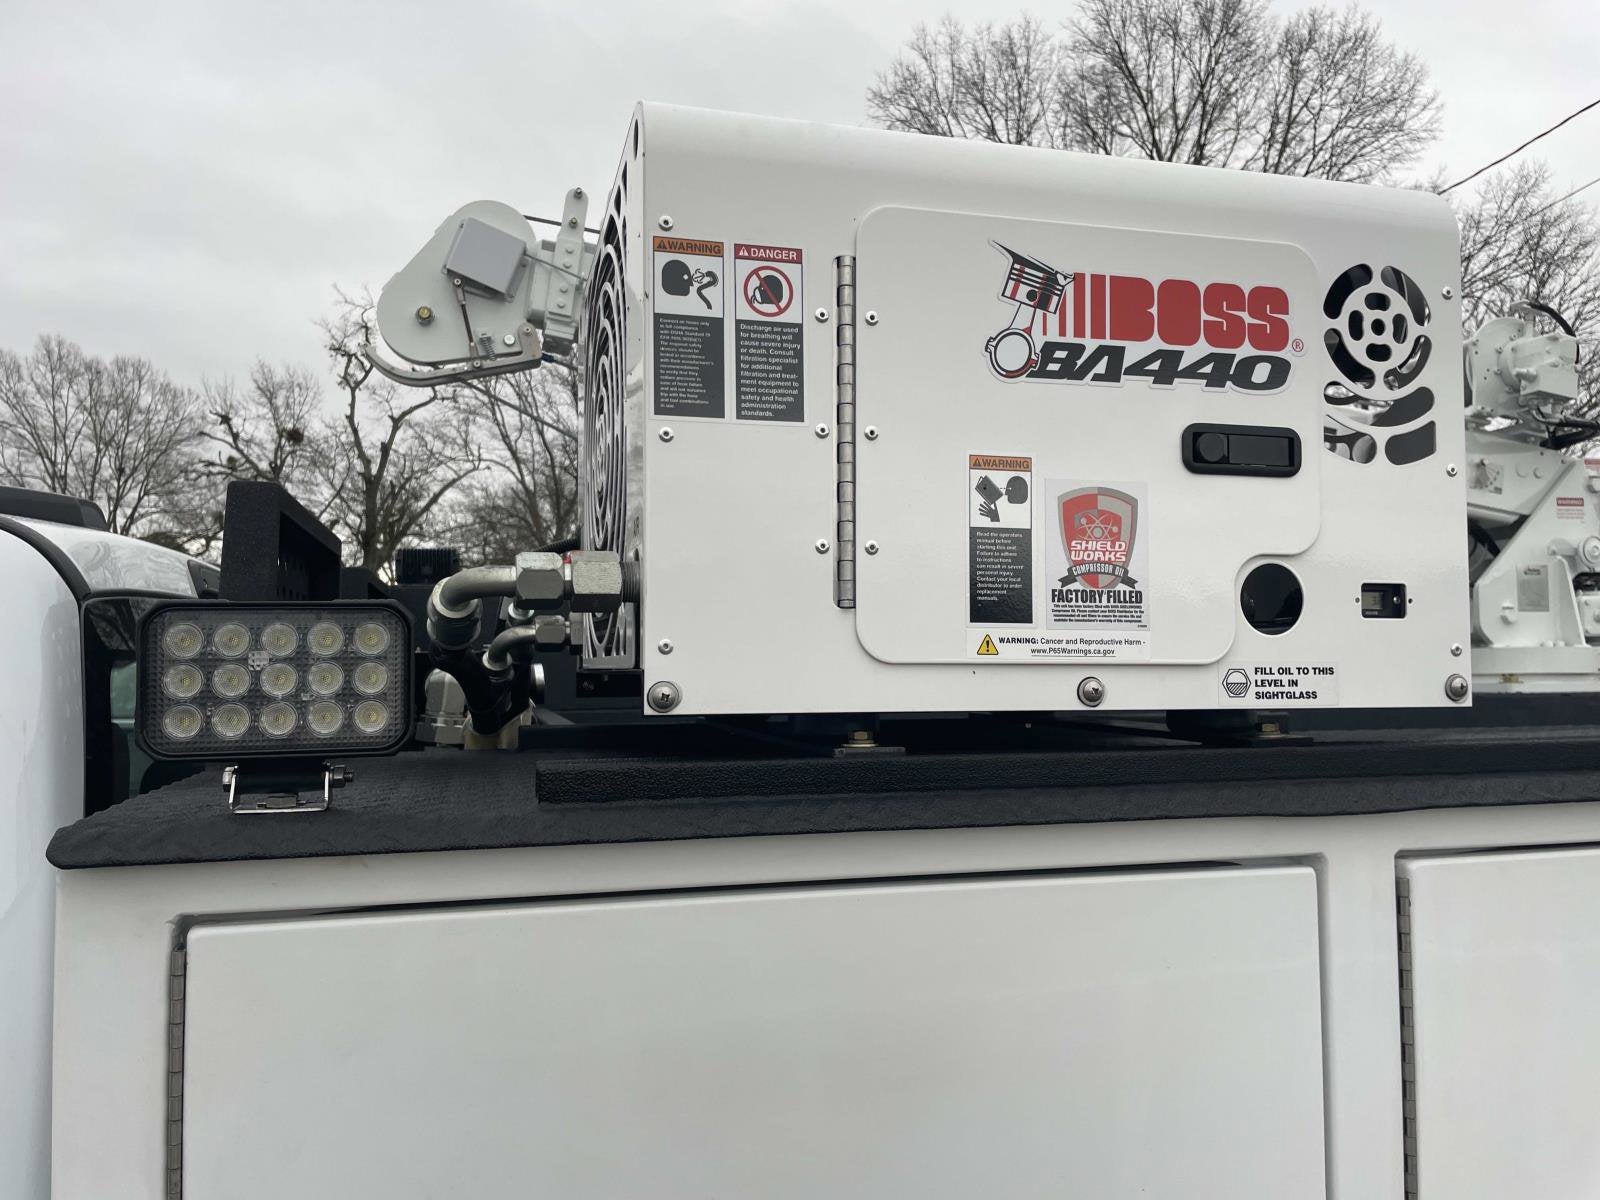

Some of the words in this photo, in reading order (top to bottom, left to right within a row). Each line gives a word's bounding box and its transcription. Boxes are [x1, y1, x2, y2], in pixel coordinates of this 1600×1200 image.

[668, 241, 720, 254] WARNING
[751, 248, 796, 260] DANGER
[1110, 275, 1289, 352] BOSS
[741, 324, 772, 332] Discharge
[1026, 341, 1291, 390] BA440
[982, 458, 1029, 468] WARNING
[1071, 540, 1126, 550] SHIELD
[1071, 551, 1126, 561] WORKS
[1072, 563, 1113, 575] COMPRESSOR
[1052, 589, 1105, 603] FACTORY
[1107, 591, 1142, 603] FILLED
[1031, 648, 1115, 656] www.P65Warnings.ca.gov
